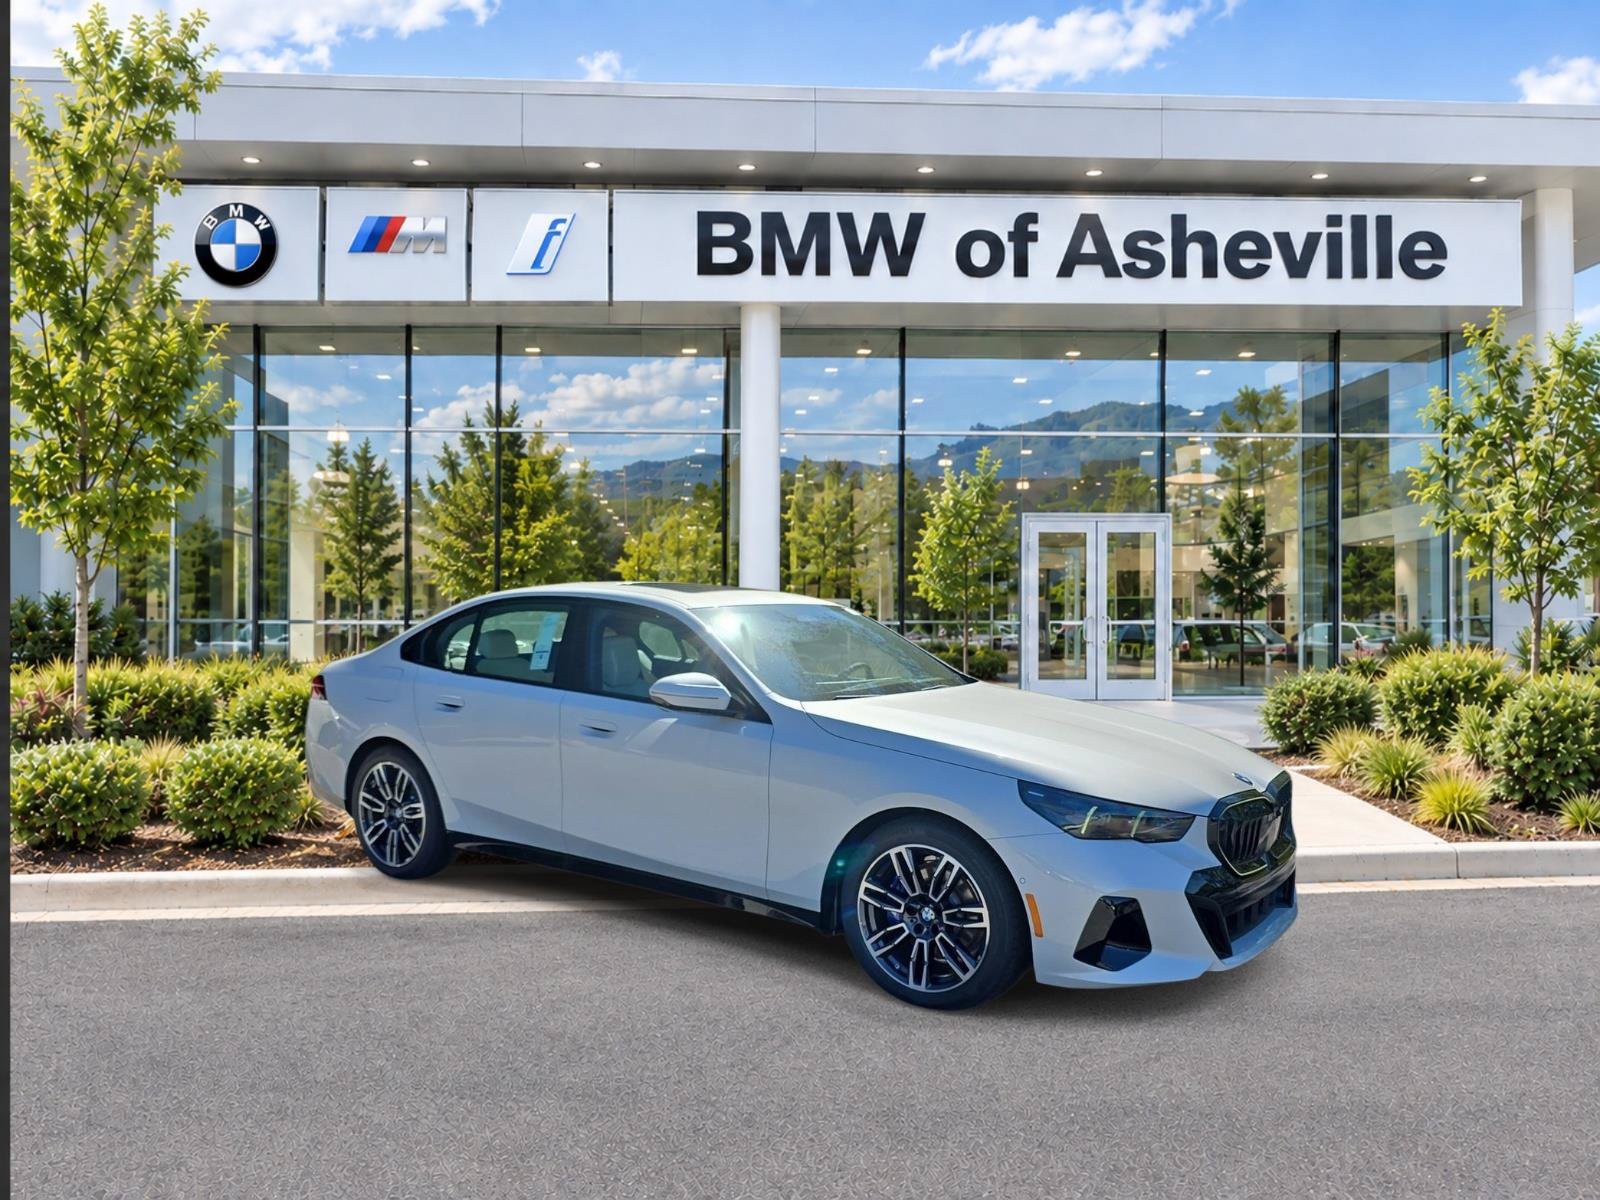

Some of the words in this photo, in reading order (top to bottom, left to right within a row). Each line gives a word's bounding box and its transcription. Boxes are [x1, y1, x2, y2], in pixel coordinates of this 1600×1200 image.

[203, 204, 271, 230] BMW
[389, 216, 447, 254] M
[697, 210, 926, 277] BMW
[955, 212, 1039, 279] of
[1056, 213, 1448, 280] Asheville
